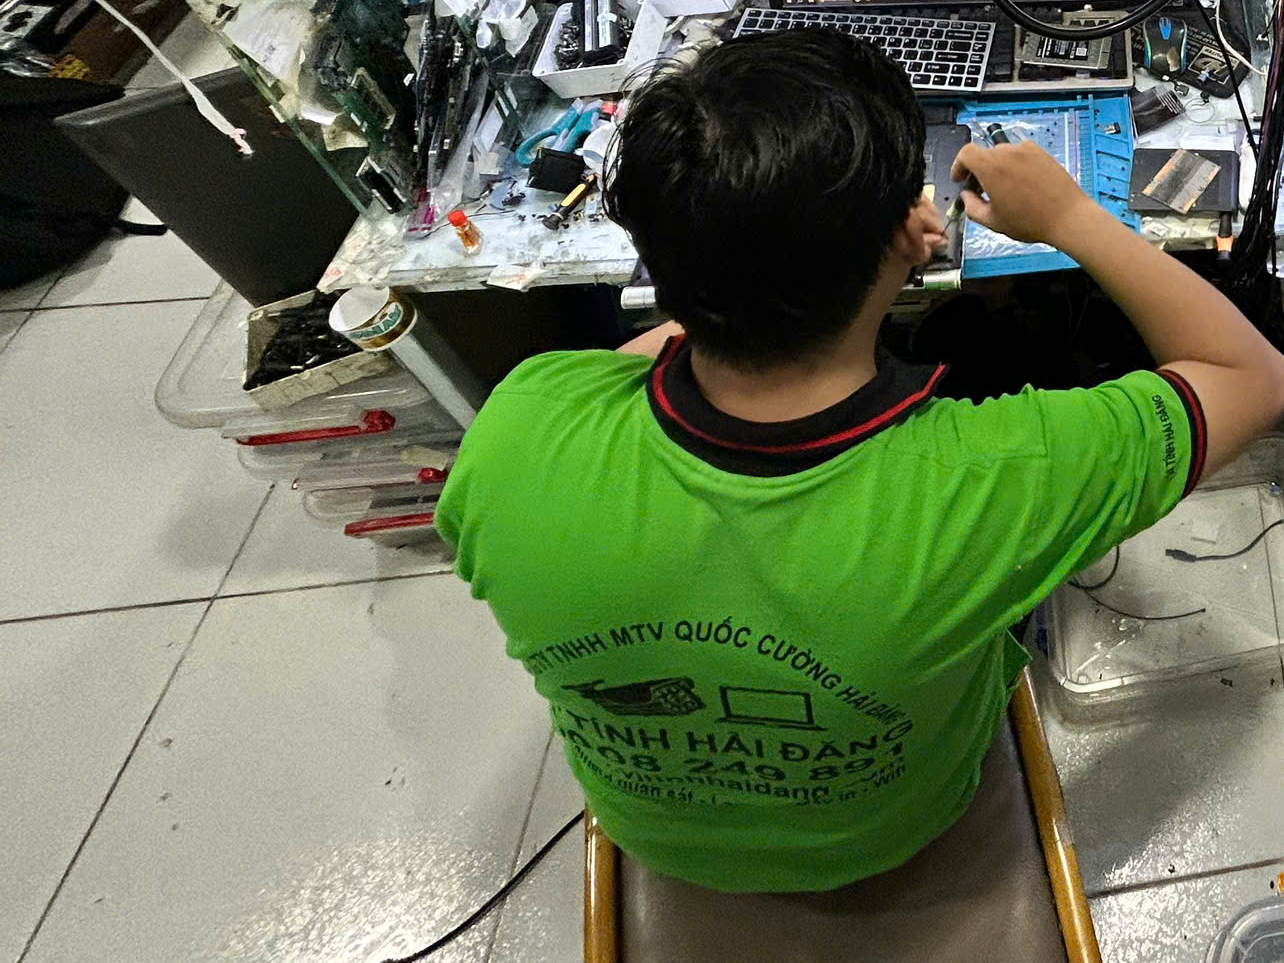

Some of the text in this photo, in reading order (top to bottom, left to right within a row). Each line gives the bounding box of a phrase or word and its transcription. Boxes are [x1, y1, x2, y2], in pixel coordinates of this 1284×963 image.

[610, 621, 663, 647] MTV
[675, 615, 752, 648] QUỐC
[757, 634, 842, 690] CƯỜNG
